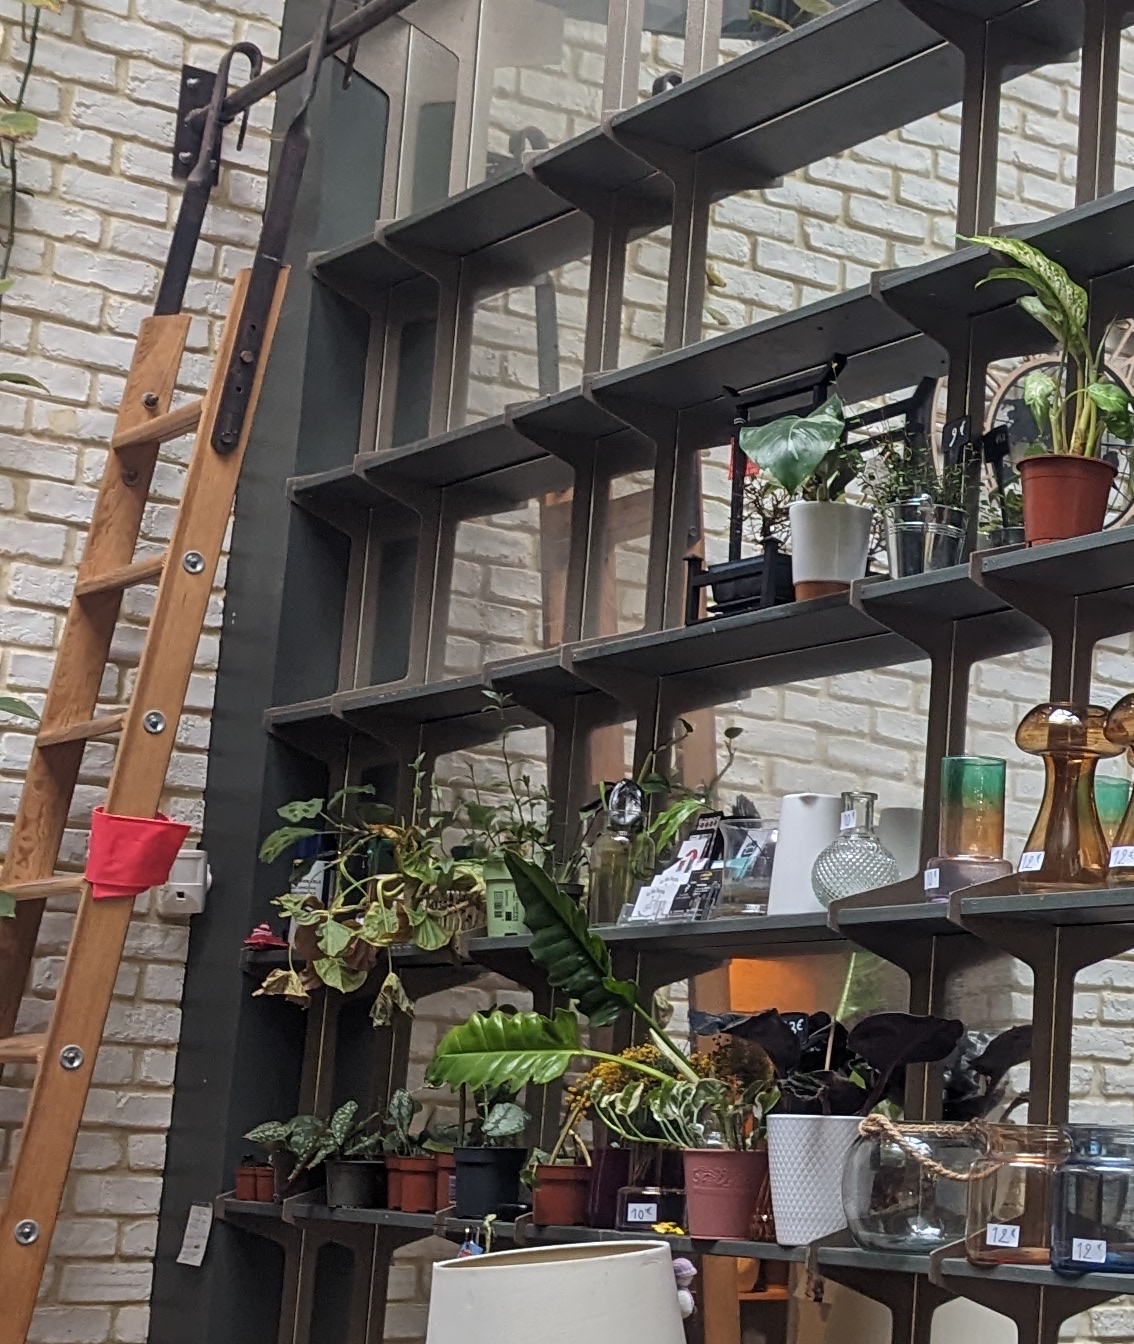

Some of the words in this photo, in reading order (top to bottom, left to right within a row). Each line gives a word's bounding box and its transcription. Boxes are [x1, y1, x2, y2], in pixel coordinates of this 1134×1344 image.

[630, 1206, 653, 1220] 10€
[991, 1225, 1016, 1244] 12€
[1077, 1241, 1103, 1260] 12€
